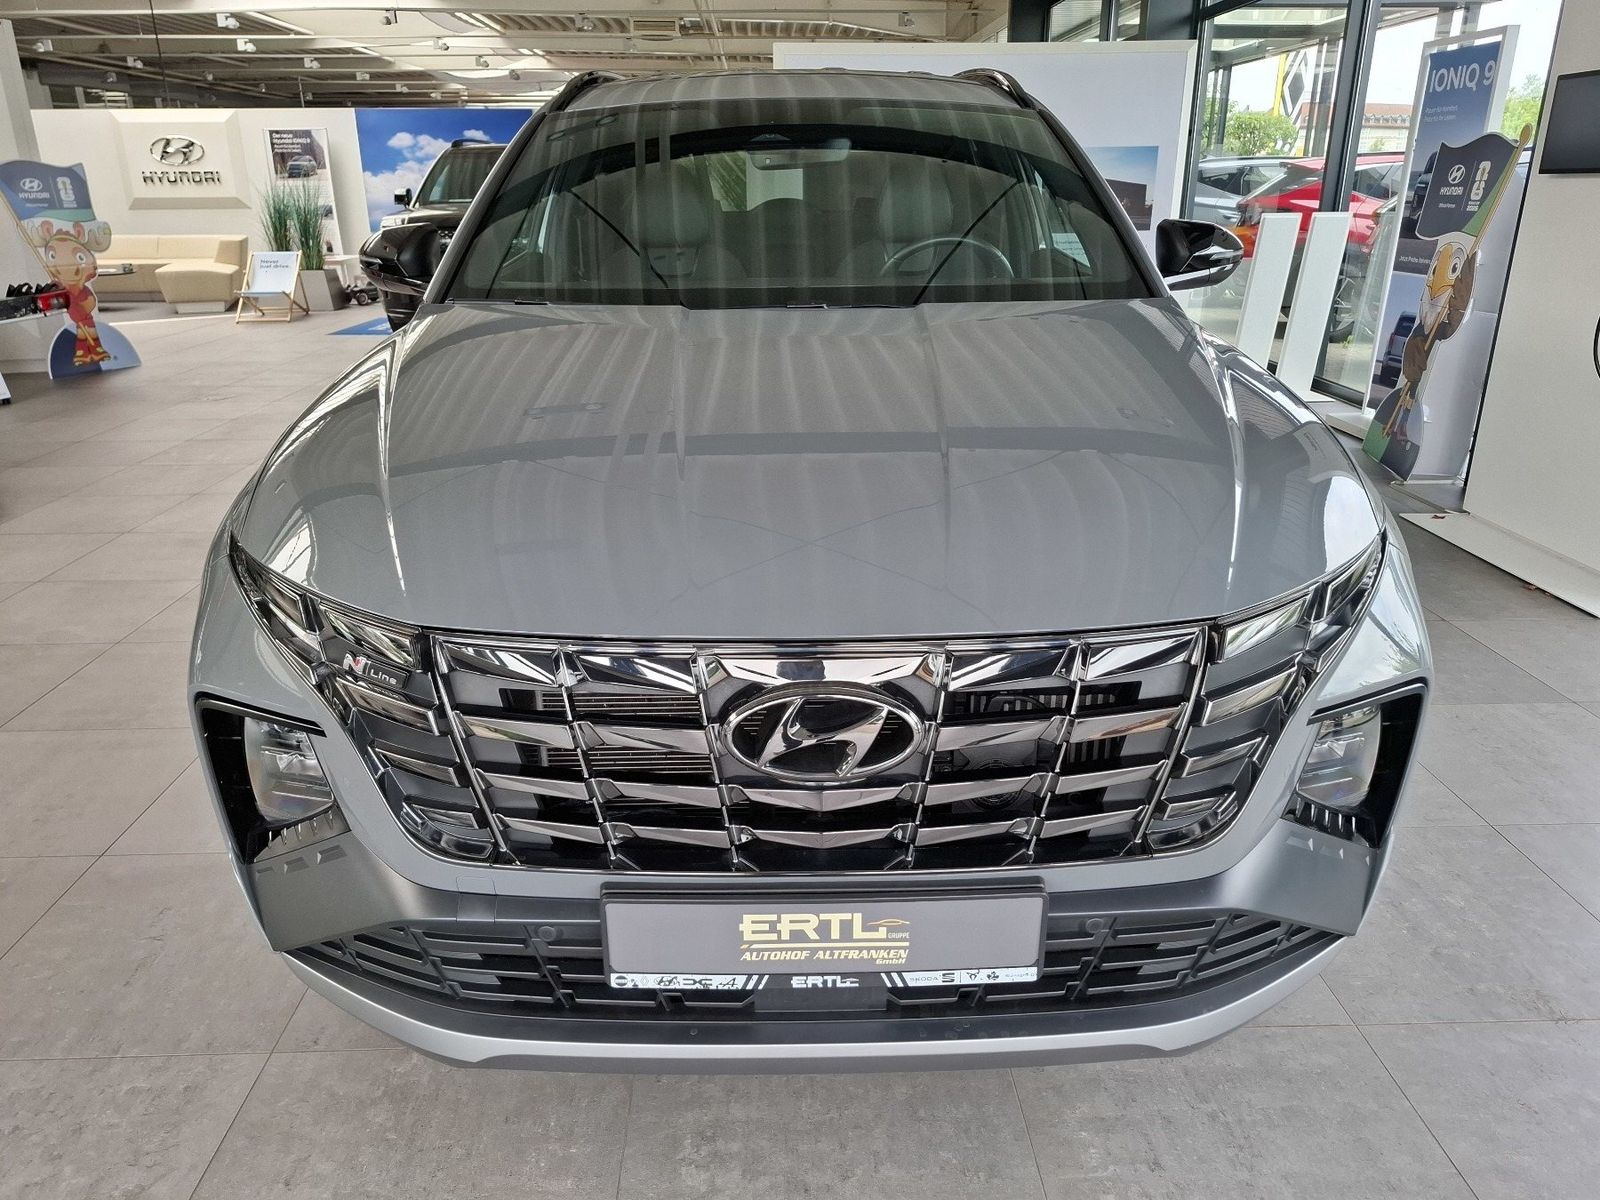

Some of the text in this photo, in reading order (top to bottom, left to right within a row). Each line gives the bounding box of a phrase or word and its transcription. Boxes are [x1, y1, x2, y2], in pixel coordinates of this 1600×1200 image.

[1429, 60, 1496, 92] IONIQ 9
[142, 170, 221, 183] HYUNDAI
[19, 191, 50, 199] HYUNDAI
[1440, 186, 1464, 196] HYUNDAI
[370, 669, 397, 685] Line
[739, 913, 887, 941] ERTL
[740, 949, 909, 961] AUTOHOF ALTFRANKEN
[790, 975, 860, 988] ERTL
